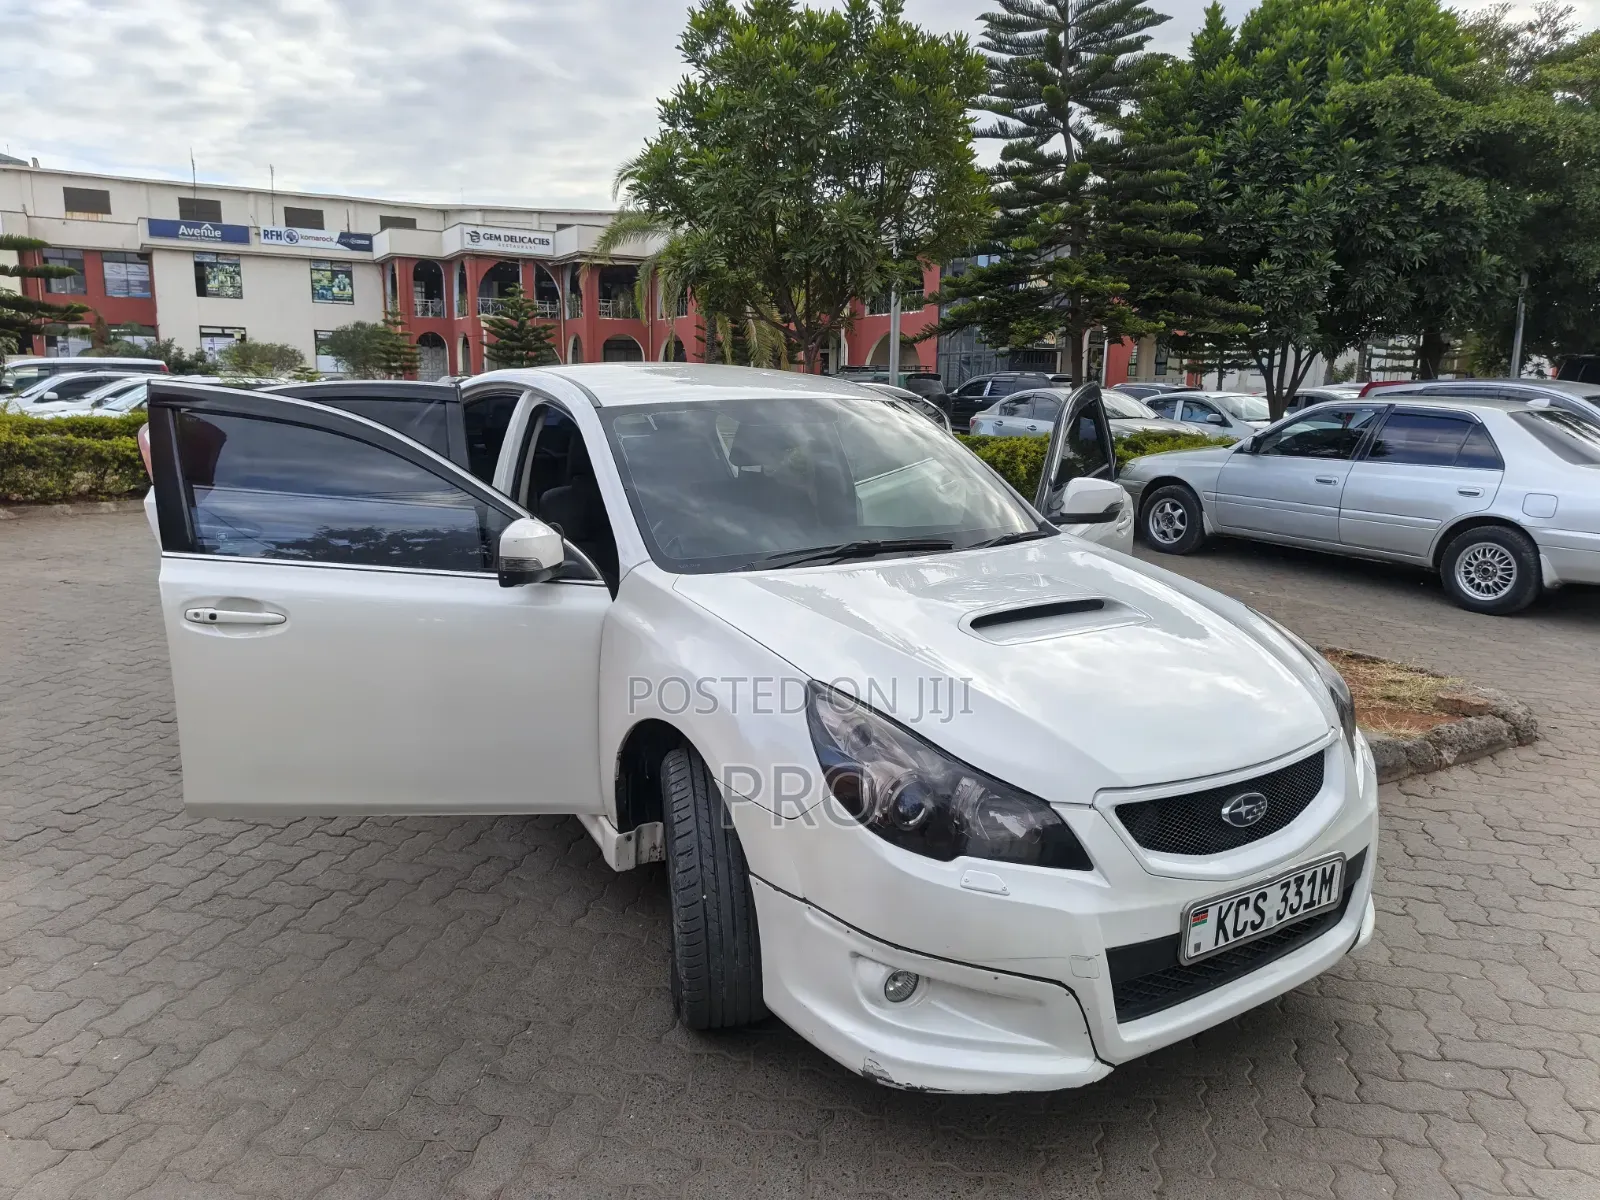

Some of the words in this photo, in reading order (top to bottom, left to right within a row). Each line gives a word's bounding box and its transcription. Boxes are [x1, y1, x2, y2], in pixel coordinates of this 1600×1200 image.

[178, 224, 222, 238] Avenue
[263, 229, 282, 241] RFH
[482, 232, 502, 242] GEM
[503, 234, 550, 246] DELICACIES
[1214, 891, 1268, 947] KCS
[1275, 863, 1336, 922] 331M
